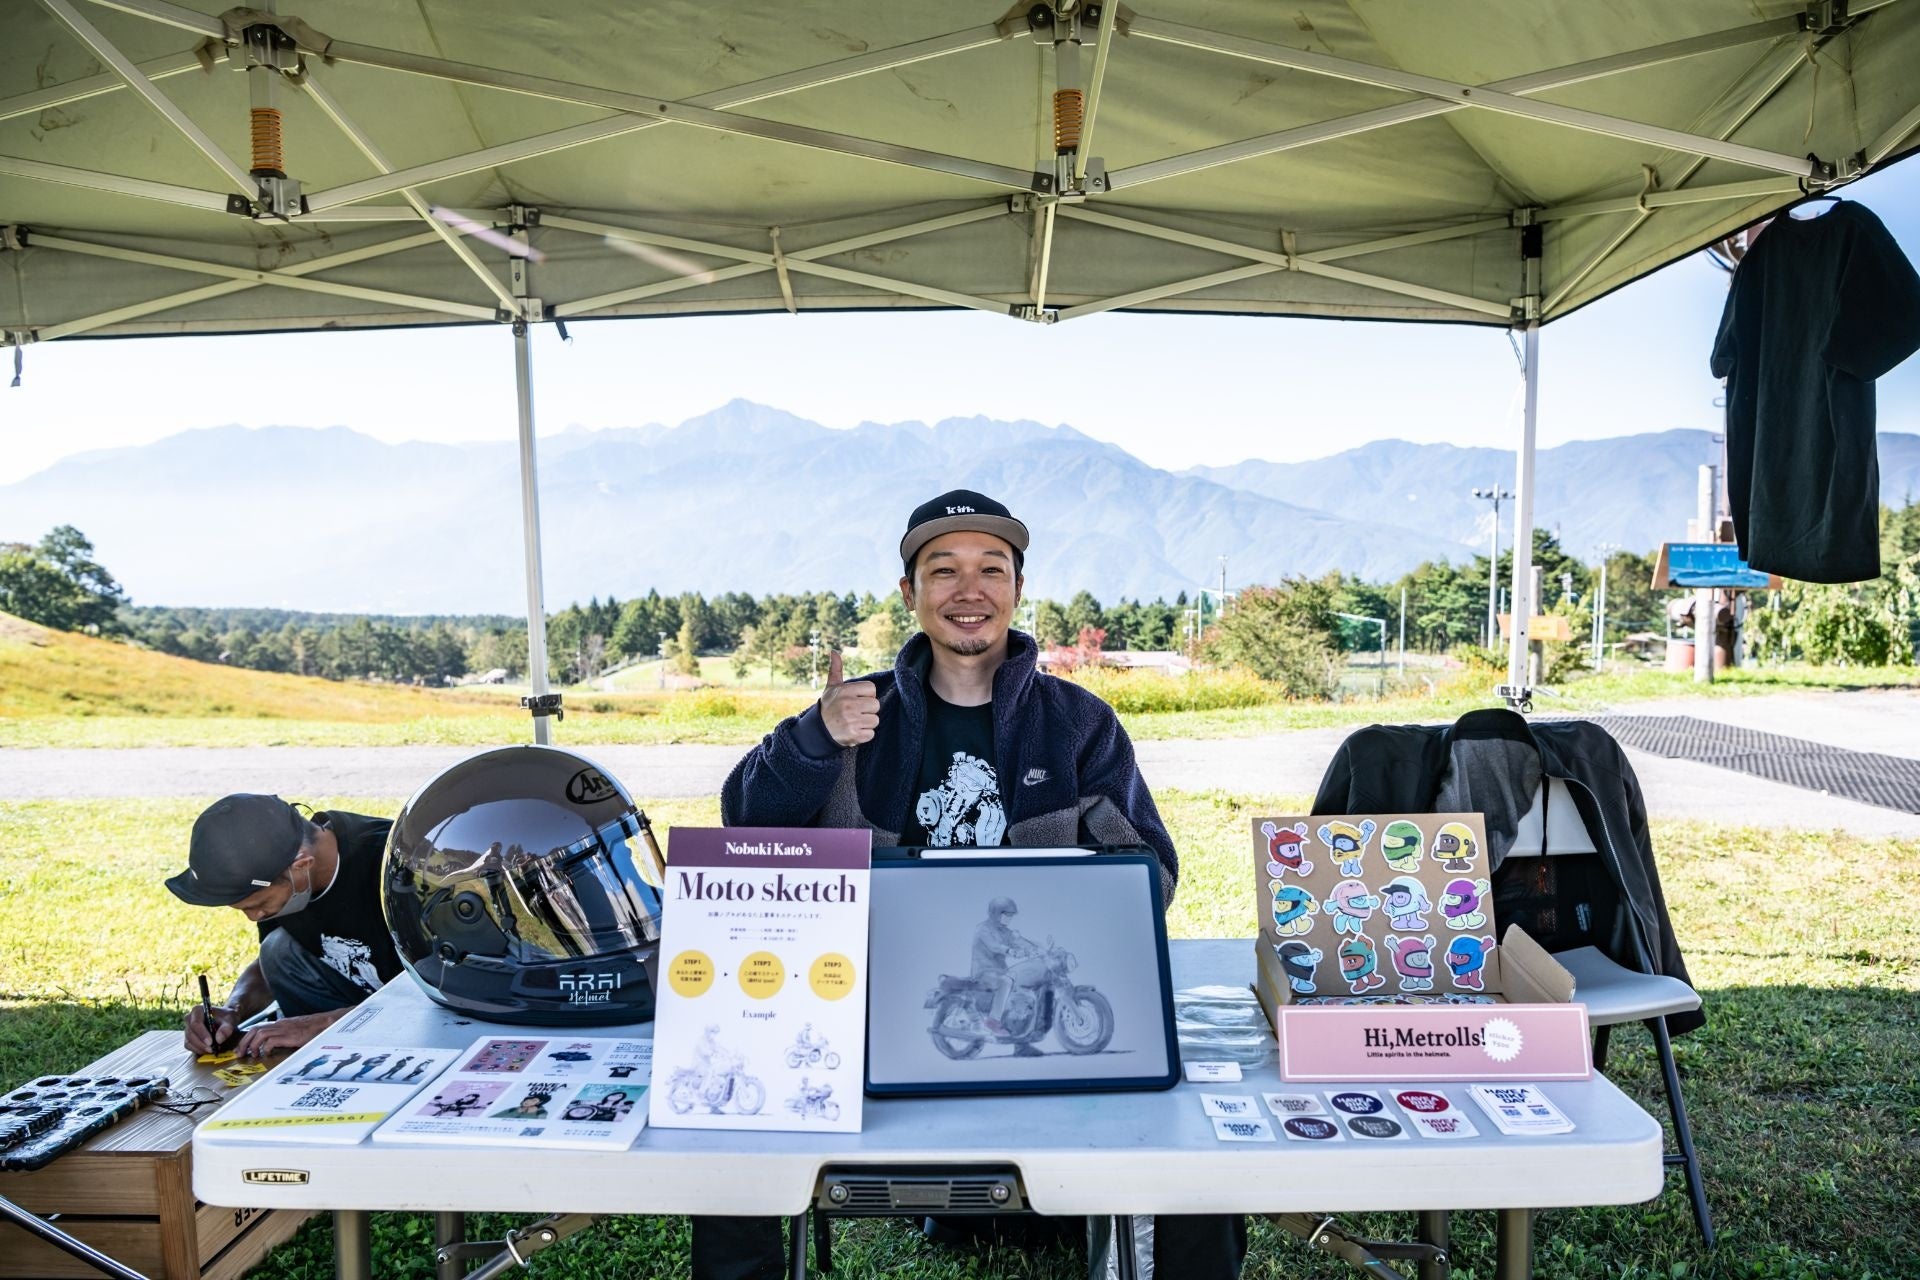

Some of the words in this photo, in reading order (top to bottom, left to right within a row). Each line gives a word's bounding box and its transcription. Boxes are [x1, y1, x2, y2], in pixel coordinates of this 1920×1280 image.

[1028, 768, 1046, 779] NIKE
[725, 841, 772, 855] Nobuki
[677, 872, 755, 901] Moto
[761, 873, 857, 903] sketch
[560, 973, 621, 990] ARAI
[569, 990, 611, 1005] Helmet
[742, 1009, 777, 1021] Example
[1364, 1027, 1486, 1050] Hi,Metrolls!
[250, 1172, 301, 1182] LIFETIME
